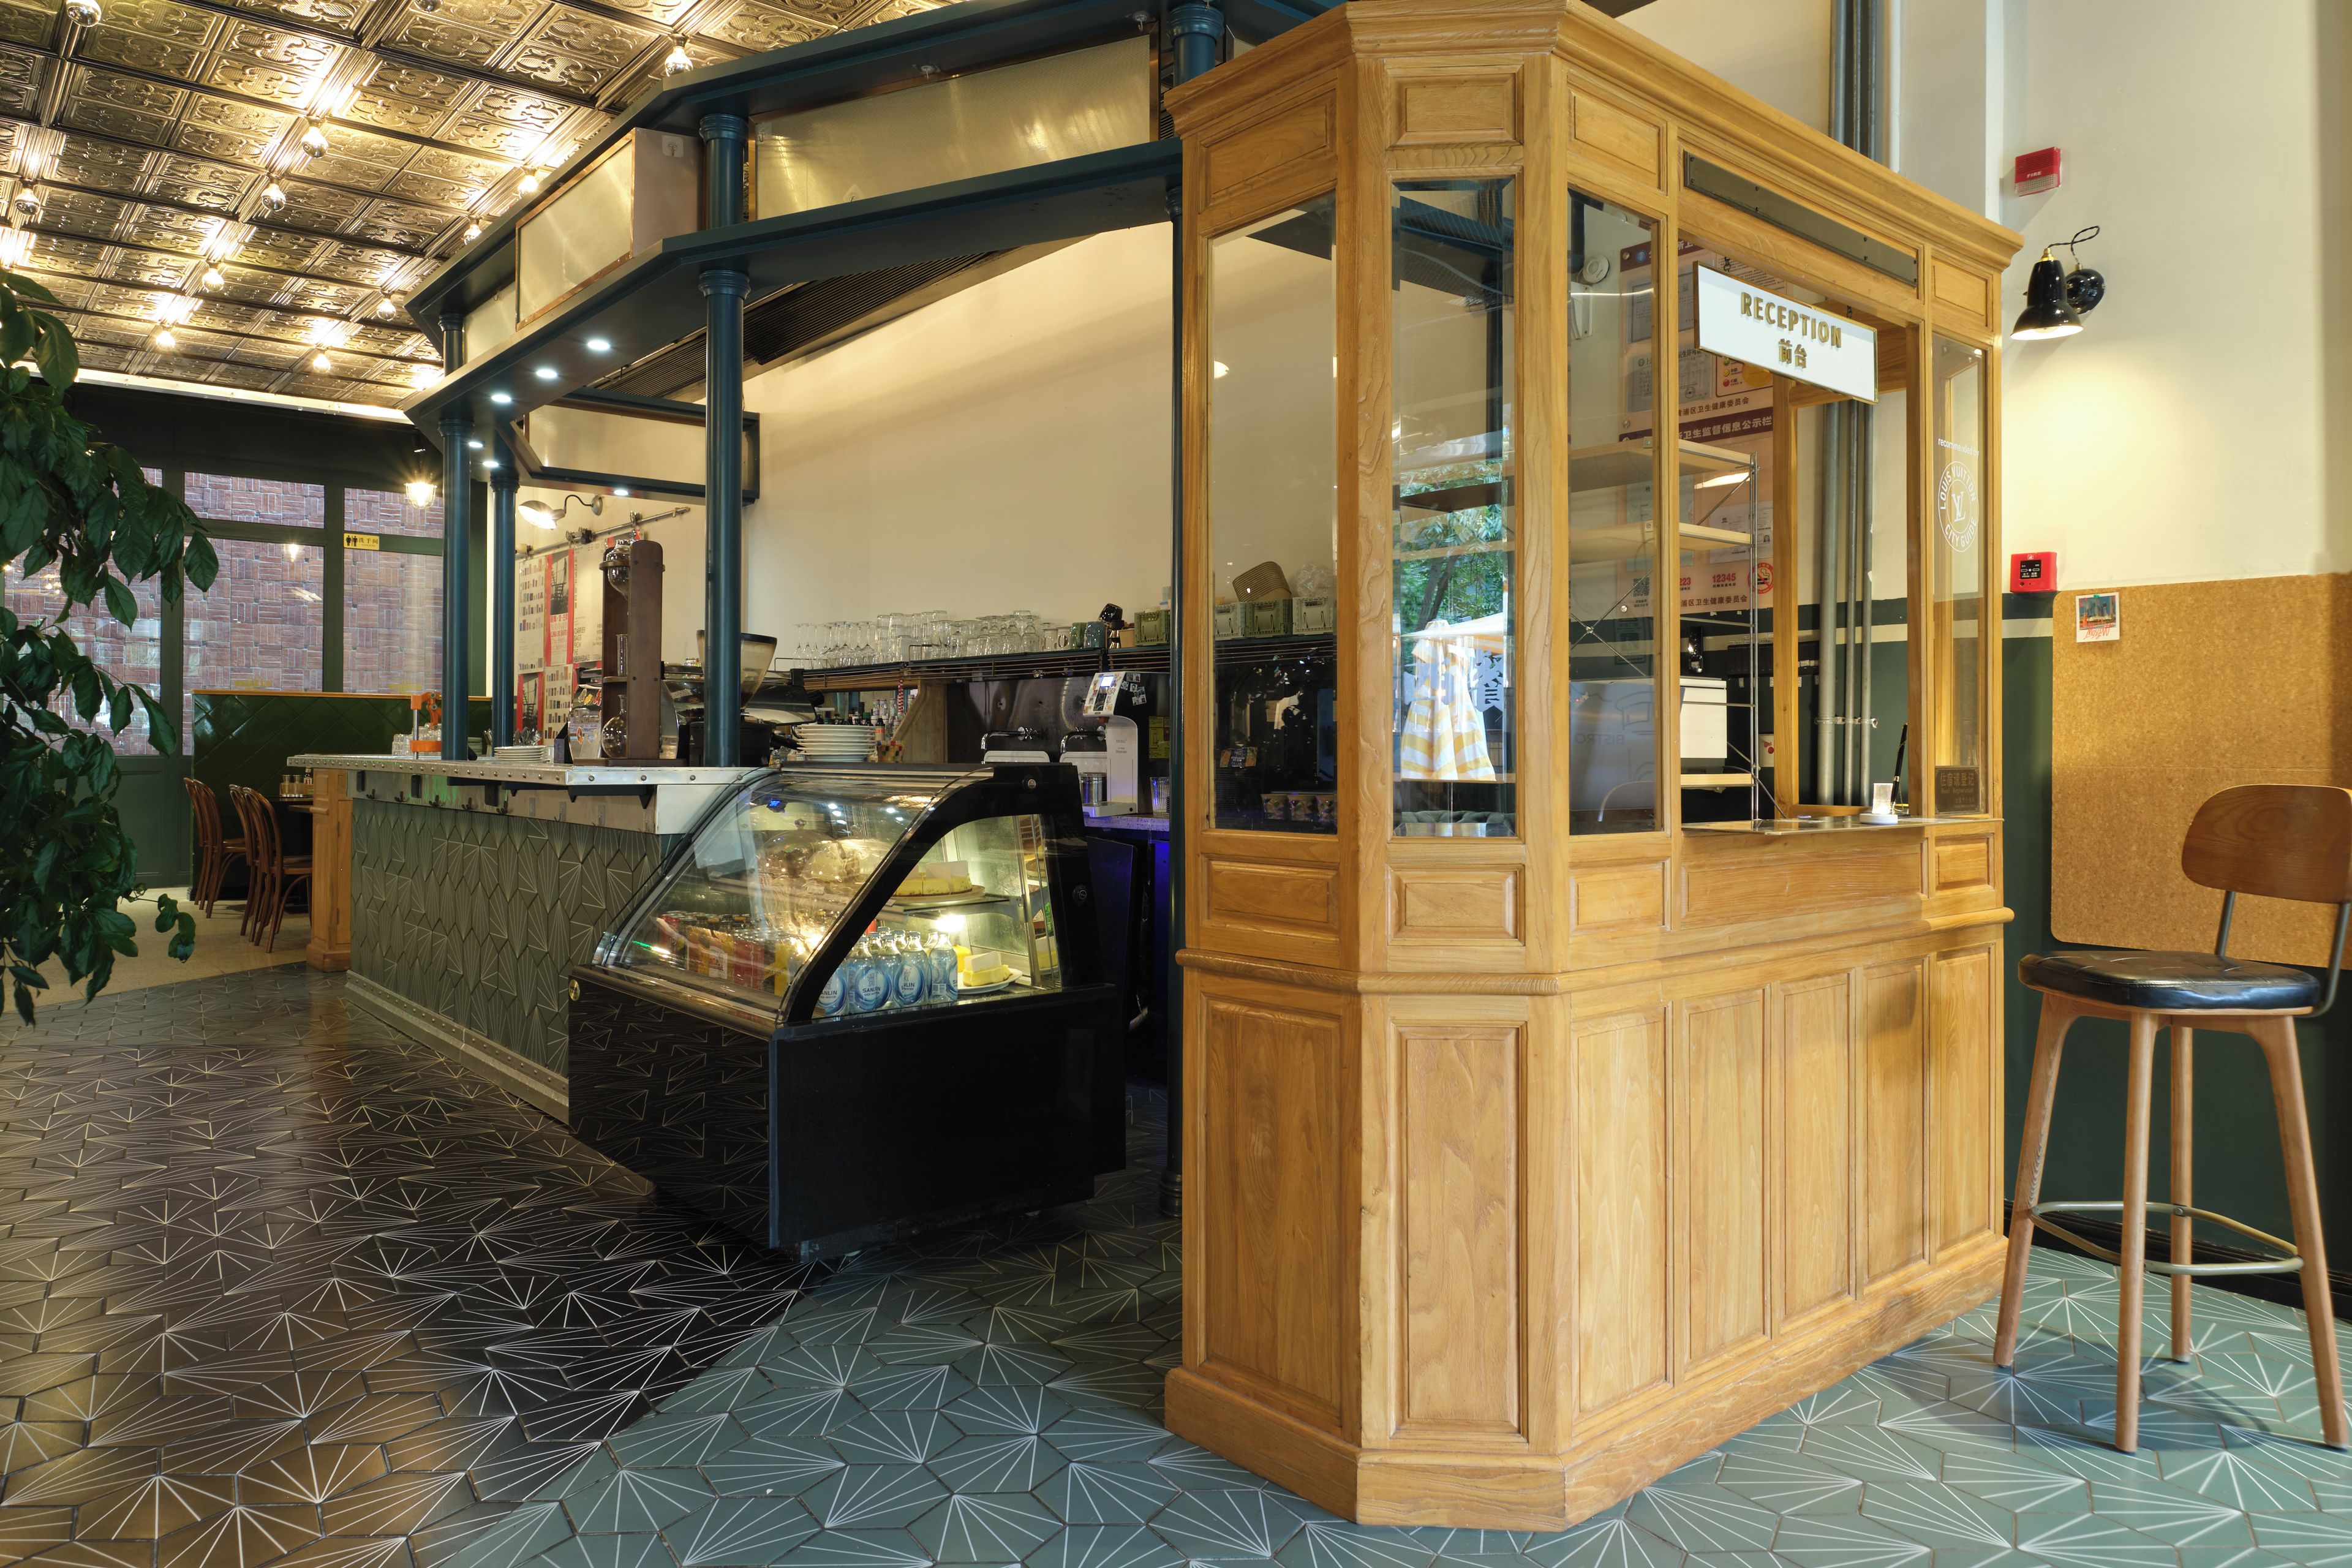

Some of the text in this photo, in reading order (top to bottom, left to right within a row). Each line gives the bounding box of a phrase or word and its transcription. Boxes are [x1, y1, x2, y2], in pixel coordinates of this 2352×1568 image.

[1741, 292, 1842, 348] RECEPTION
[1778, 338, 1807, 369] 前台
[1938, 438, 1979, 458] recommended by
[1940, 465, 1977, 510] LOUIS VUITTON
[1944, 516, 1978, 548] CITY GUIDE
[1711, 573, 1737, 583] 12345
